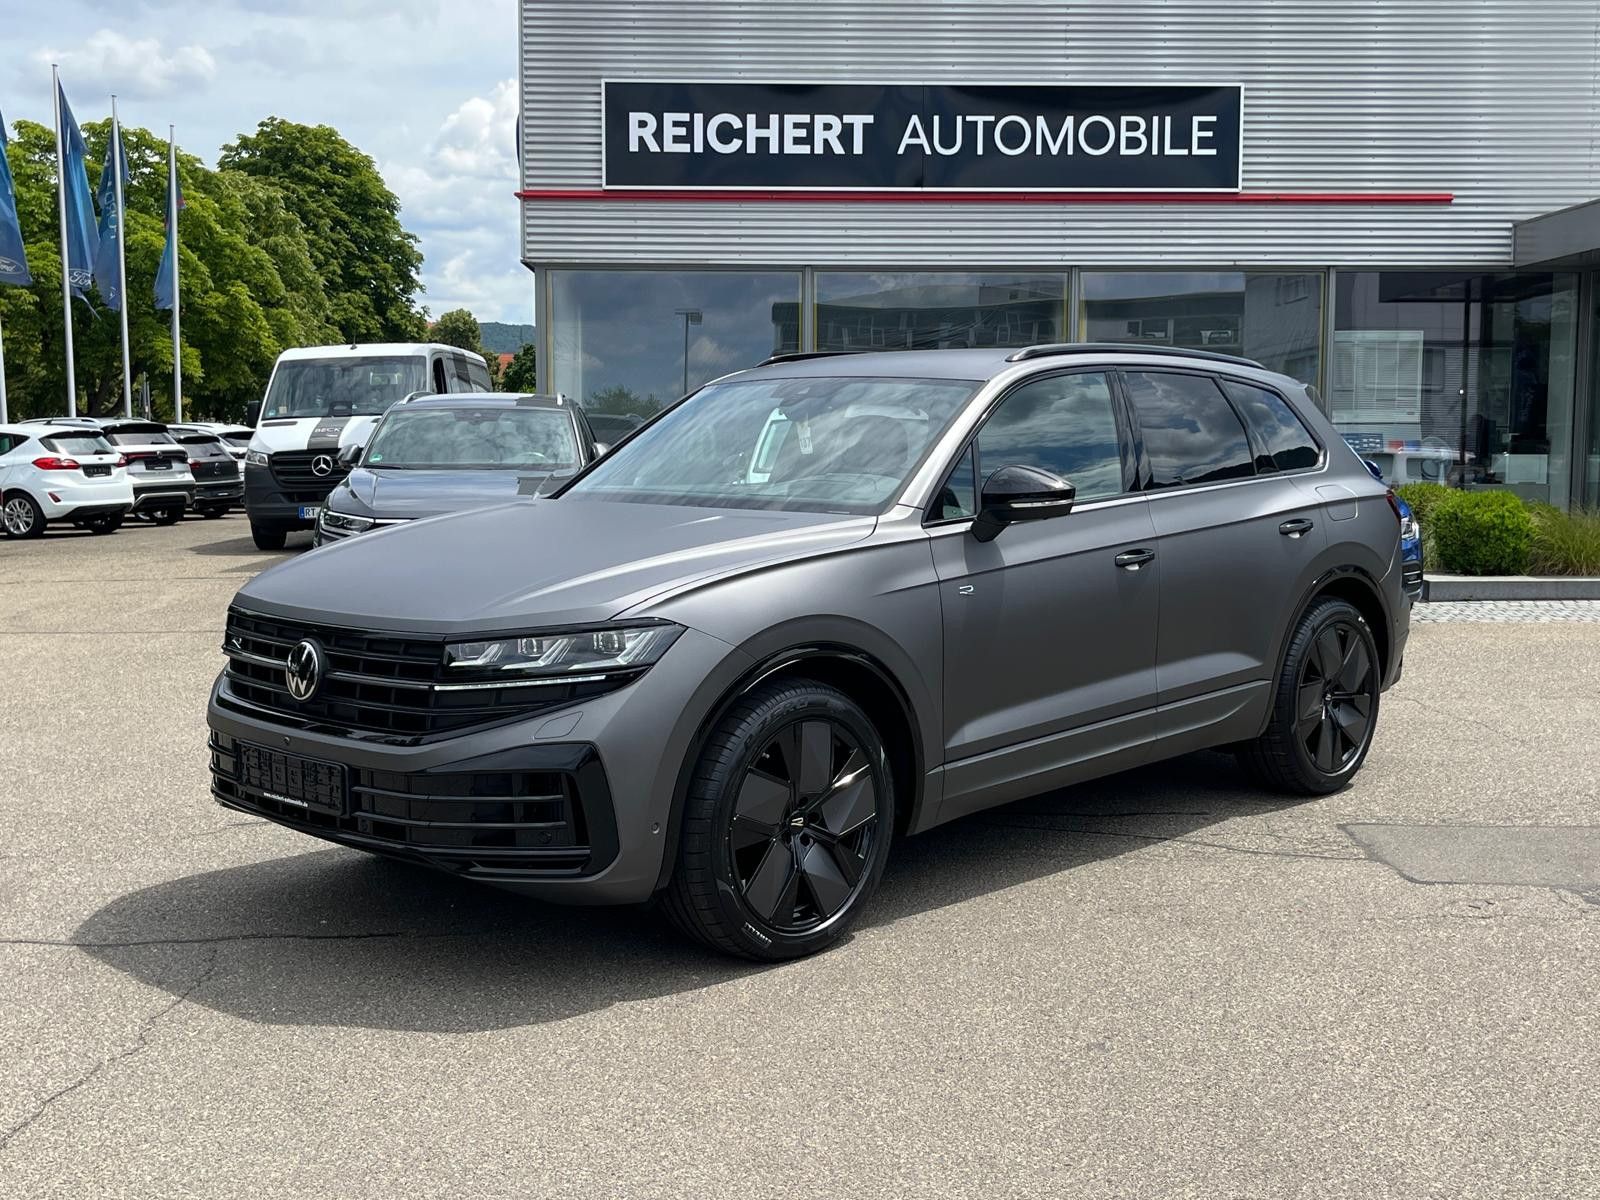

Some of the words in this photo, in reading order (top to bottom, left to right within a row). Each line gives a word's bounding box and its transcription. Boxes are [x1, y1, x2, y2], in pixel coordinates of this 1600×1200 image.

[628, 111, 874, 154] REICHERT
[897, 114, 1217, 156] AUTOMOBILE
[305, 508, 316, 517] RT
